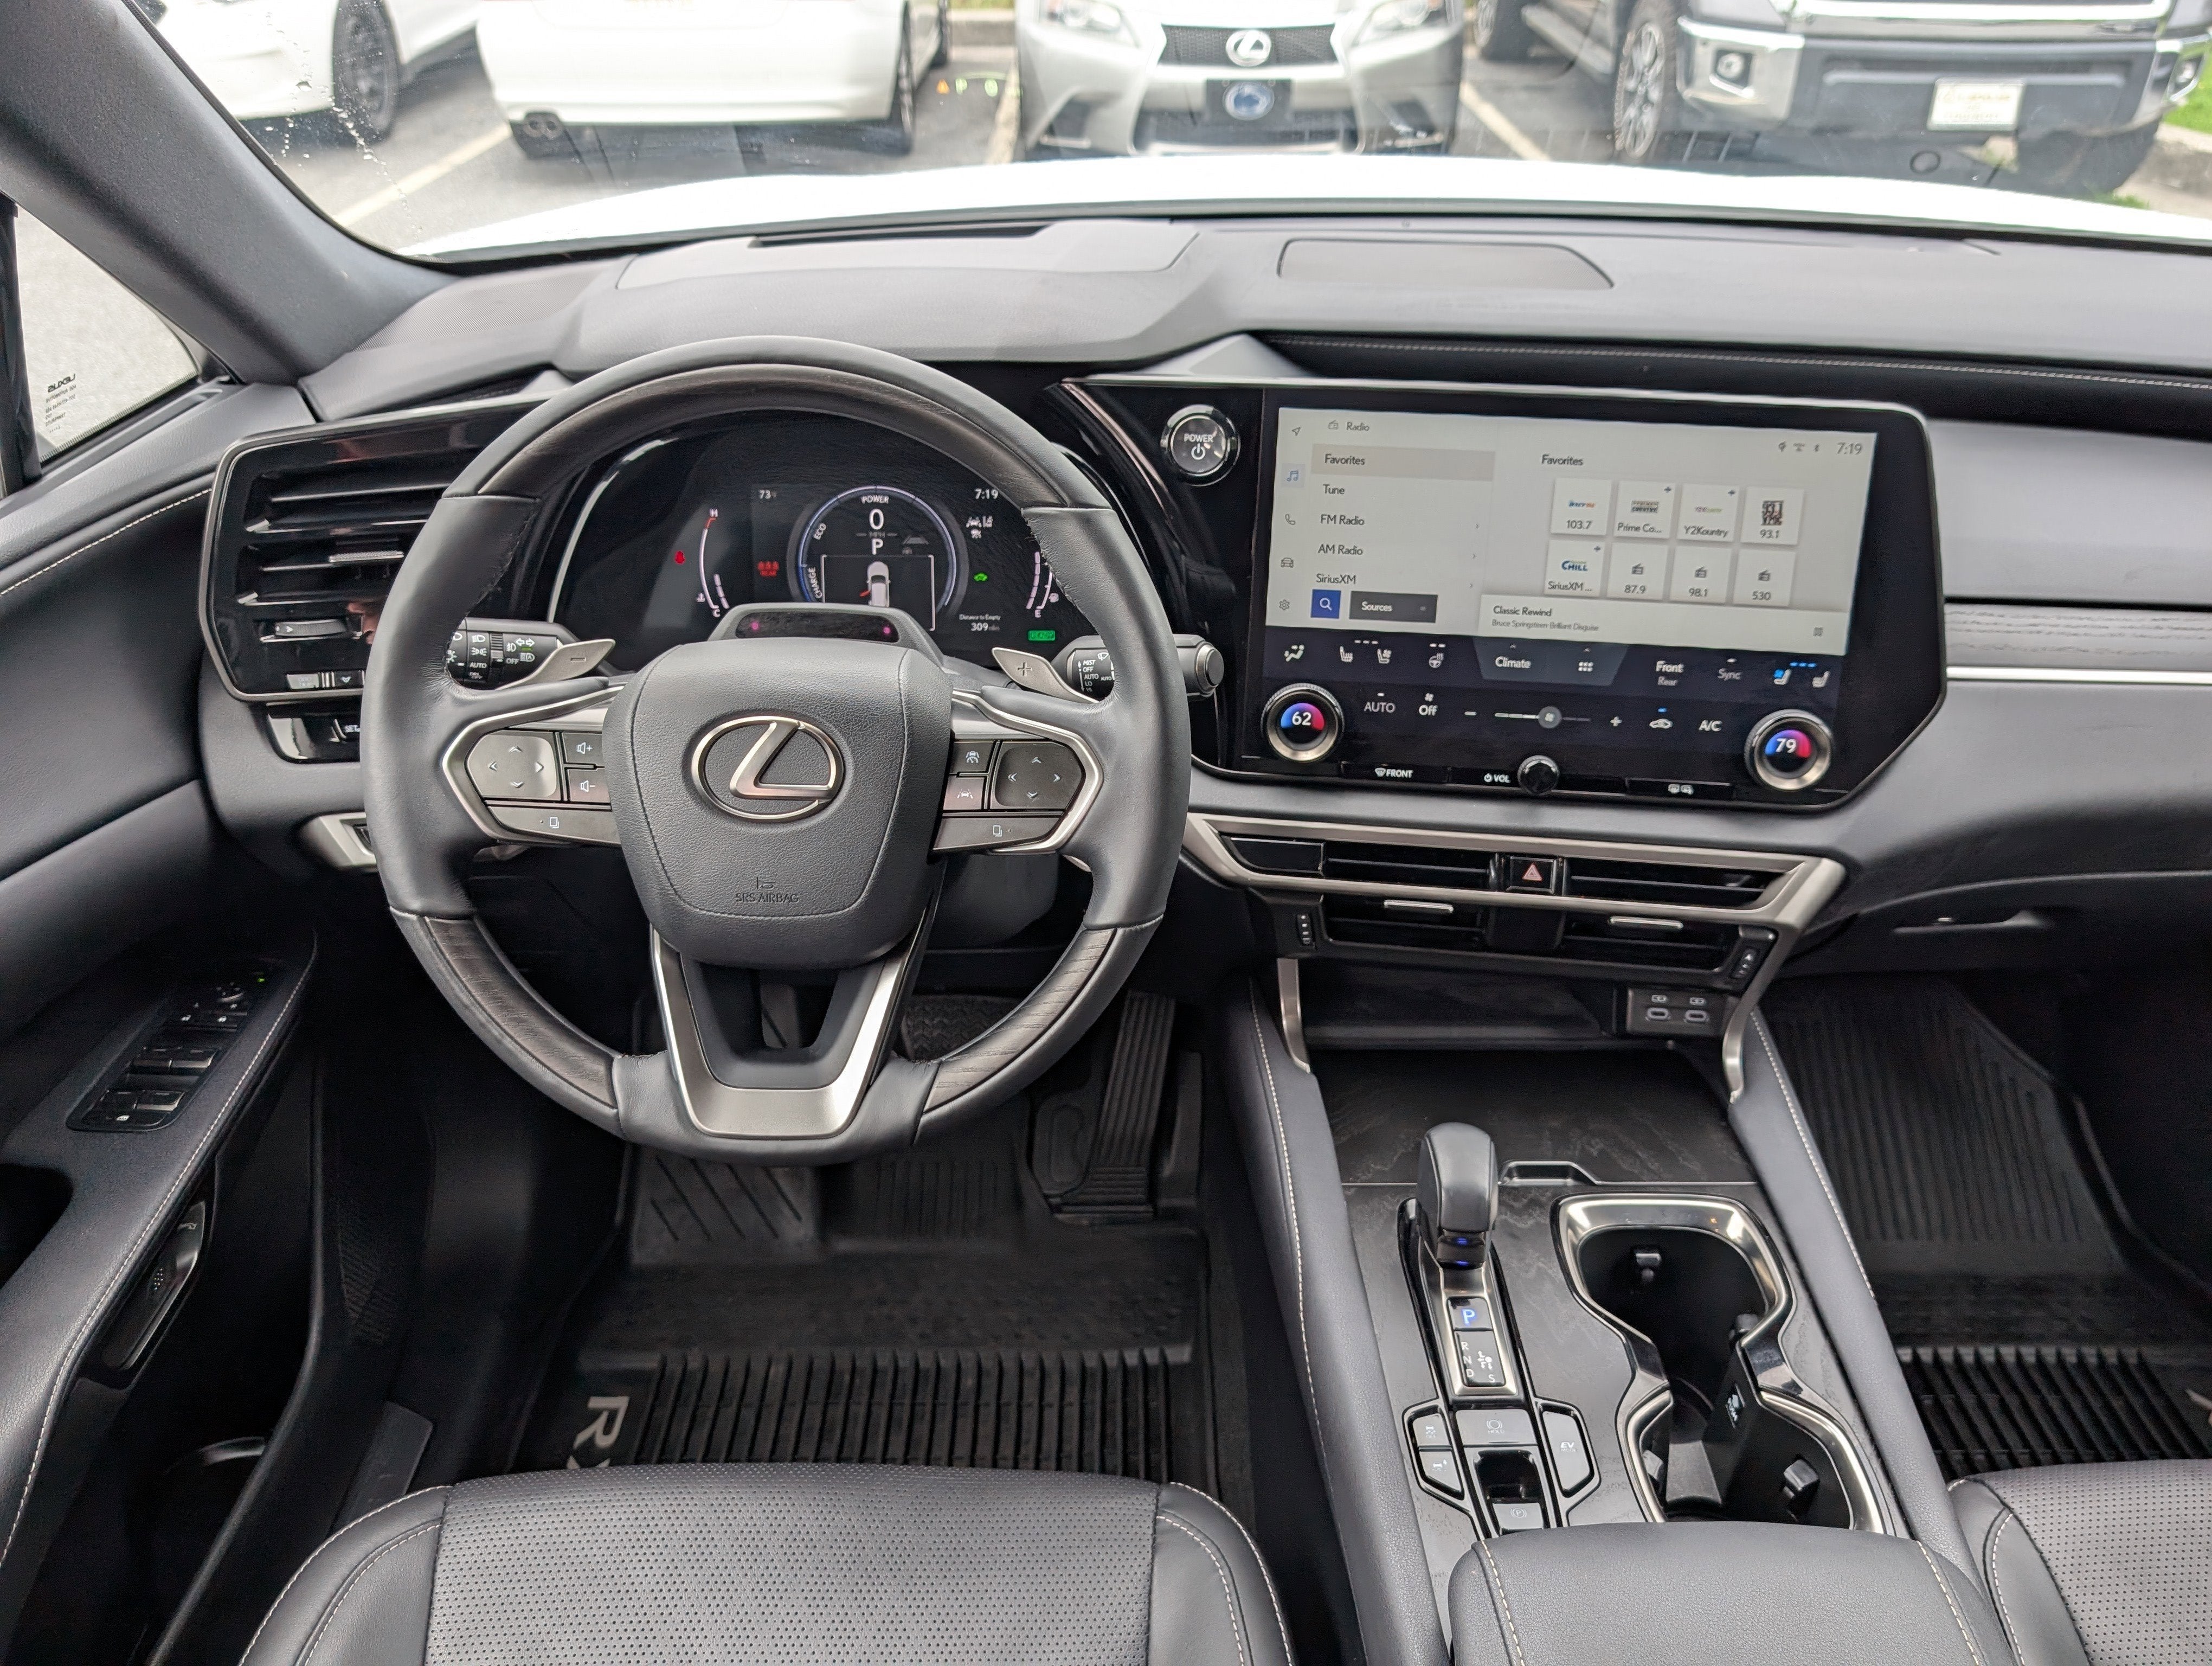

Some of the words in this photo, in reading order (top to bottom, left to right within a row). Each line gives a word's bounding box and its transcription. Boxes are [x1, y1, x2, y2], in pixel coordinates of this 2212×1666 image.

[1346, 421, 1370, 432] Radio
[1184, 433, 1214, 443] POWER
[1836, 442, 1862, 455] 7:19
[1324, 453, 1366, 466] Favorites
[1541, 454, 1583, 467] Favorites
[974, 488, 999, 499] 7:19
[1323, 484, 1345, 495] Tune
[861, 495, 890, 504] POWER
[709, 508, 718, 517] H
[869, 508, 884, 530] 0
[1320, 515, 1336, 525] FM
[1339, 515, 1365, 526] Radio
[1566, 520, 1593, 530] 103.7
[1617, 522, 1641, 532] Prime
[813, 523, 826, 540] ECO
[1684, 525, 1729, 538] Y2Kountry
[1760, 529, 1780, 539] 93.1
[871, 538, 884, 555] P
[1317, 543, 1335, 554] AM
[1338, 544, 1364, 556] Radio
[807, 567, 822, 599] CHARGE
[1316, 573, 1356, 585] SiriusXM
[1548, 580, 1583, 591] SiriusXM
[1624, 585, 1647, 594] 87.9
[1688, 587, 1708, 597] 98.1
[1752, 591, 1771, 601] 530
[712, 608, 721, 617] C
[1361, 601, 1393, 613] Sources
[1493, 605, 1520, 616] Classic
[1521, 607, 1553, 617] Rewind
[1034, 610, 1041, 618] E
[970, 622, 988, 631] 309
[1492, 619, 1510, 627] Bruce
[1495, 656, 1532, 669] Climate
[1655, 660, 1684, 674] Front
[1718, 668, 1741, 681] Sync
[1657, 676, 1679, 687] Rear
[1364, 702, 1396, 714] AUTO
[1418, 704, 1438, 716] Off
[1291, 712, 1311, 727] 62
[1699, 720, 1722, 732] A/C
[1776, 738, 1797, 753] 79
[1386, 768, 1413, 779] FRONT
[1493, 773, 1510, 784] VOL
[735, 892, 756, 903] SRS
[758, 892, 799, 903] AIRBAG
[1462, 1309, 1475, 1324] P
[1461, 1341, 1469, 1350] R
[1463, 1355, 1472, 1364] N
[1465, 1369, 1475, 1377] D
[1488, 1374, 1496, 1383] S
